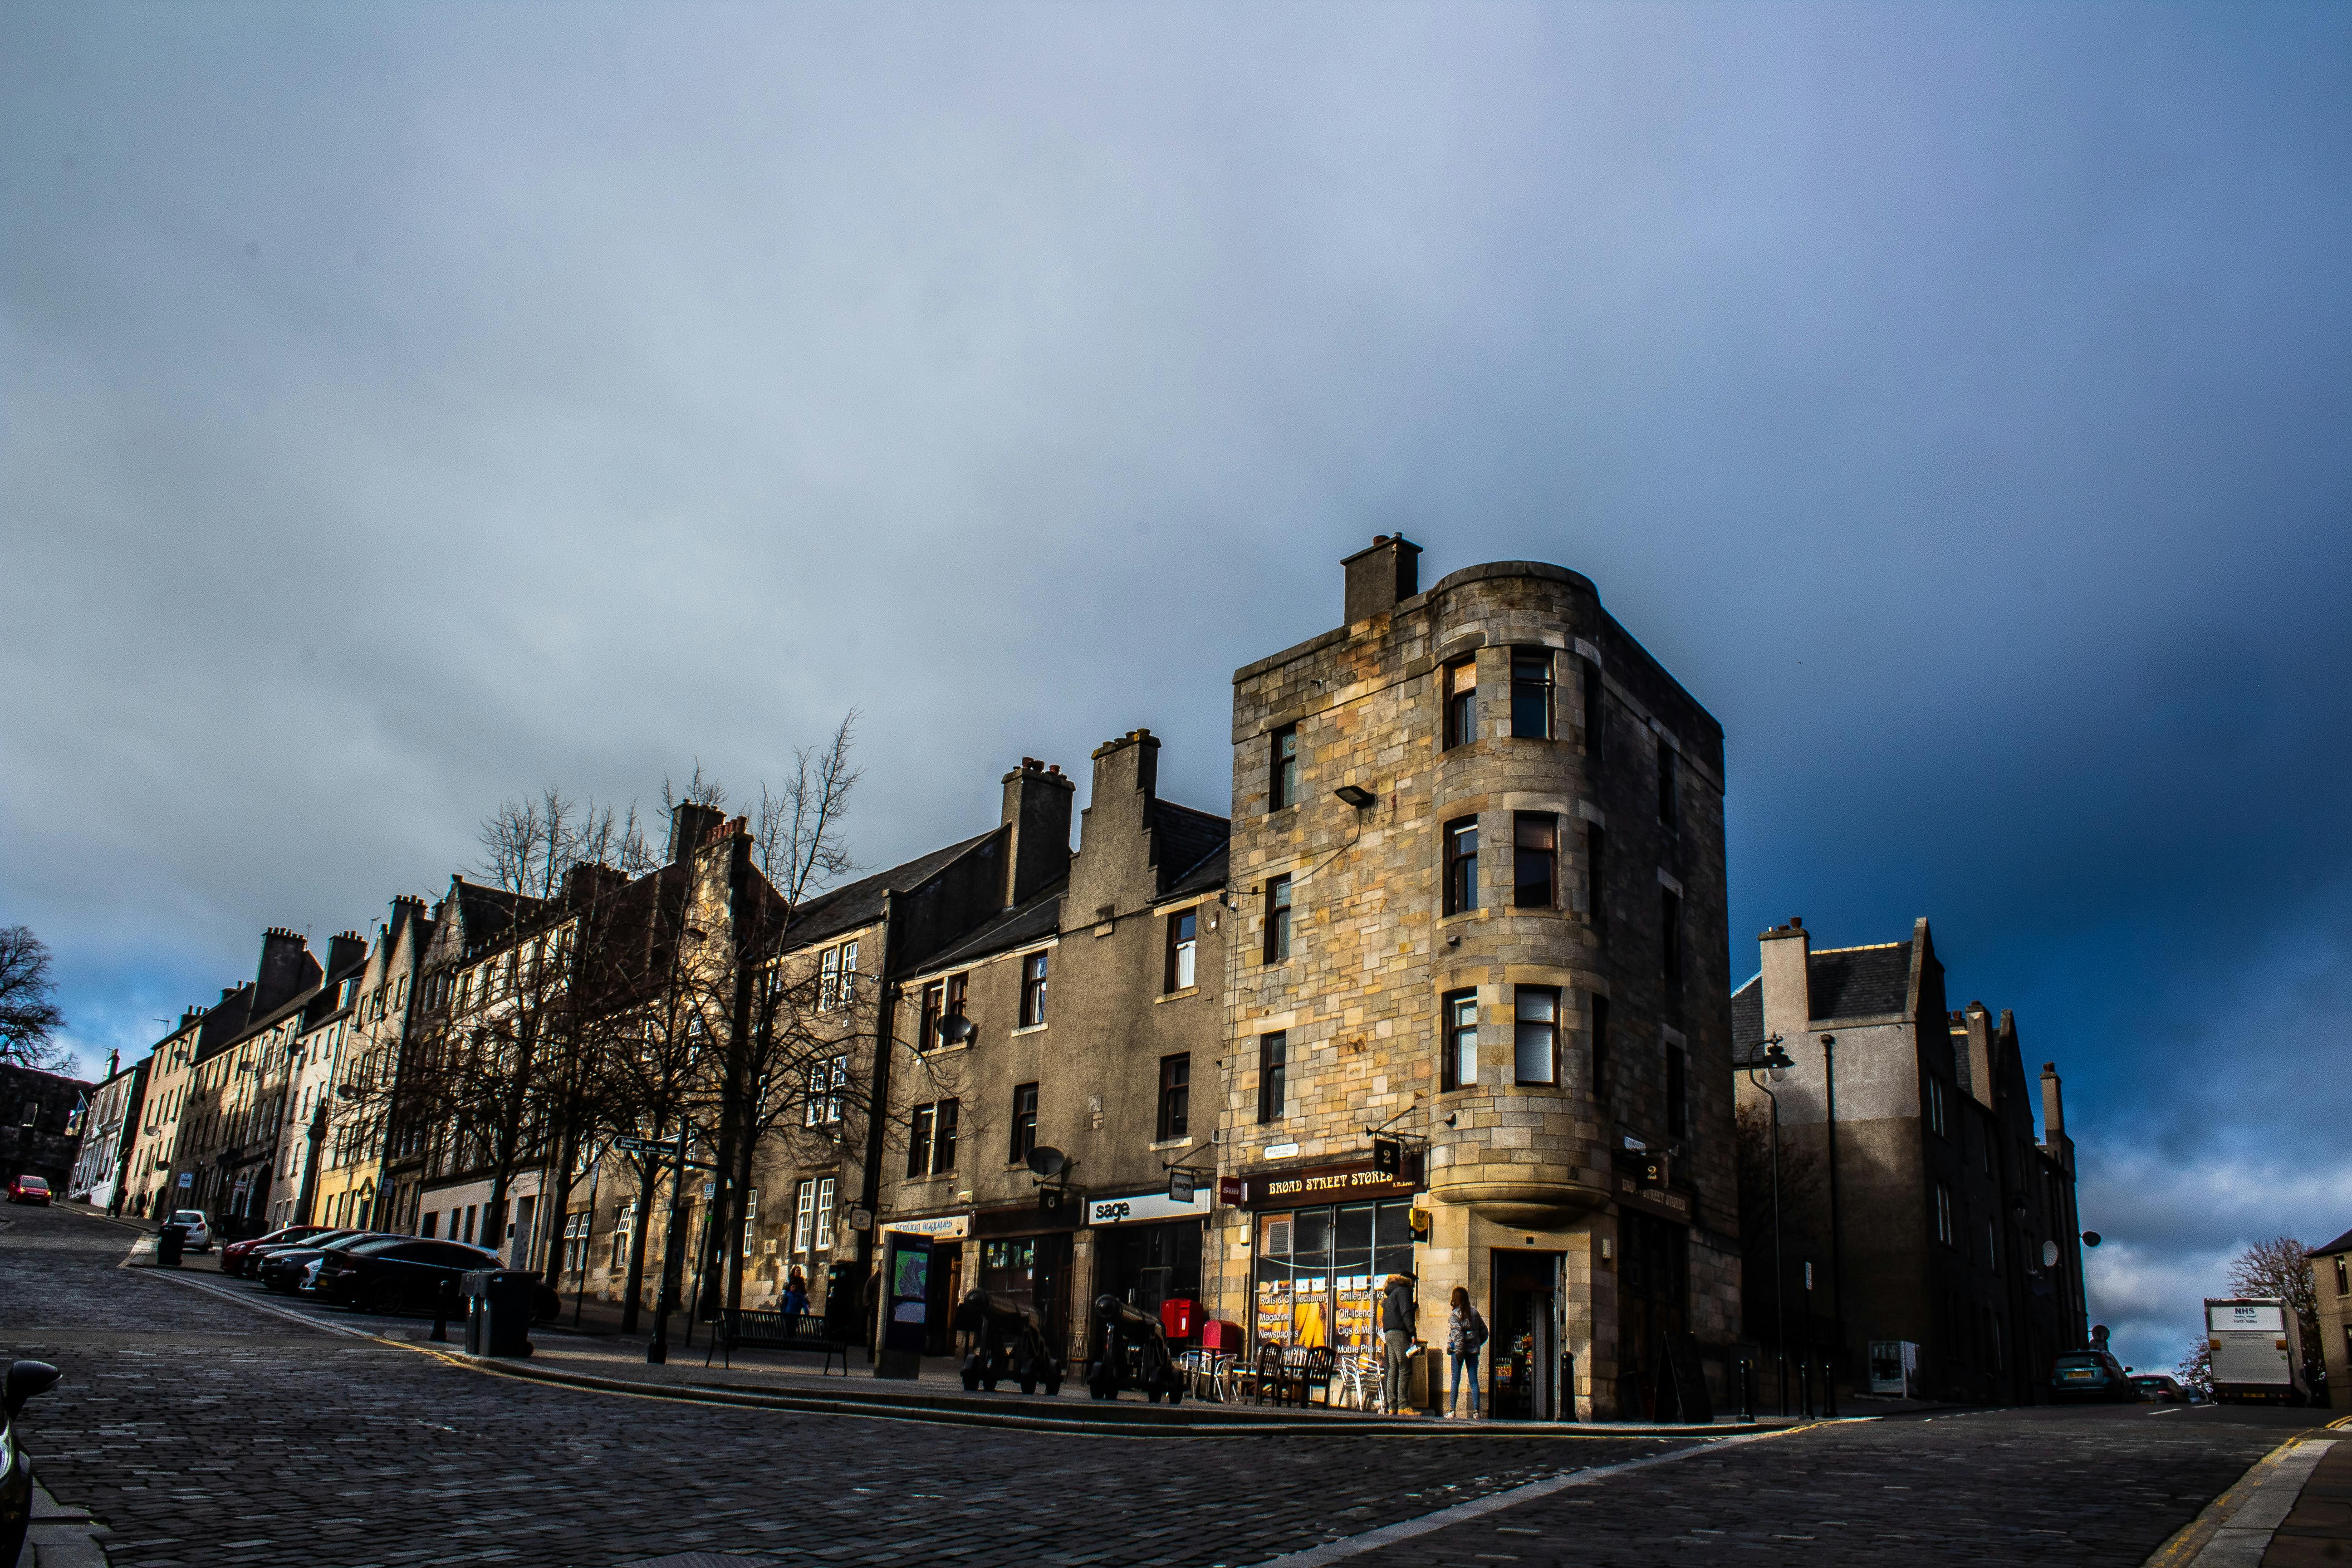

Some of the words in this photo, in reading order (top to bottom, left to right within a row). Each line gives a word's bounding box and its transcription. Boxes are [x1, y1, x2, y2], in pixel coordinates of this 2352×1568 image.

[1383, 1150, 1391, 1164] 2
[1647, 1166, 1657, 1180] 2
[1269, 1181, 1302, 1195] BROAD
[1306, 1175, 1348, 1191] STREET
[1352, 1171, 1393, 1186] STORES
[1048, 1196, 1055, 1208] 6
[1096, 1202, 1130, 1223] sage
[1260, 1295, 1276, 1304] Rolls
[1277, 1294, 1283, 1304] &
[1284, 1294, 1328, 1304] Cfectionery
[1339, 1291, 1361, 1301] Chilled
[1363, 1290, 1384, 1300] Drks
[1338, 1308, 1372, 1318] Off-licenc
[1259, 1329, 1298, 1340] Newspaps
[1338, 1325, 1352, 1337] Cigs
[1354, 1325, 1359, 1334] &
[1337, 1344, 1359, 1353] Mobile
